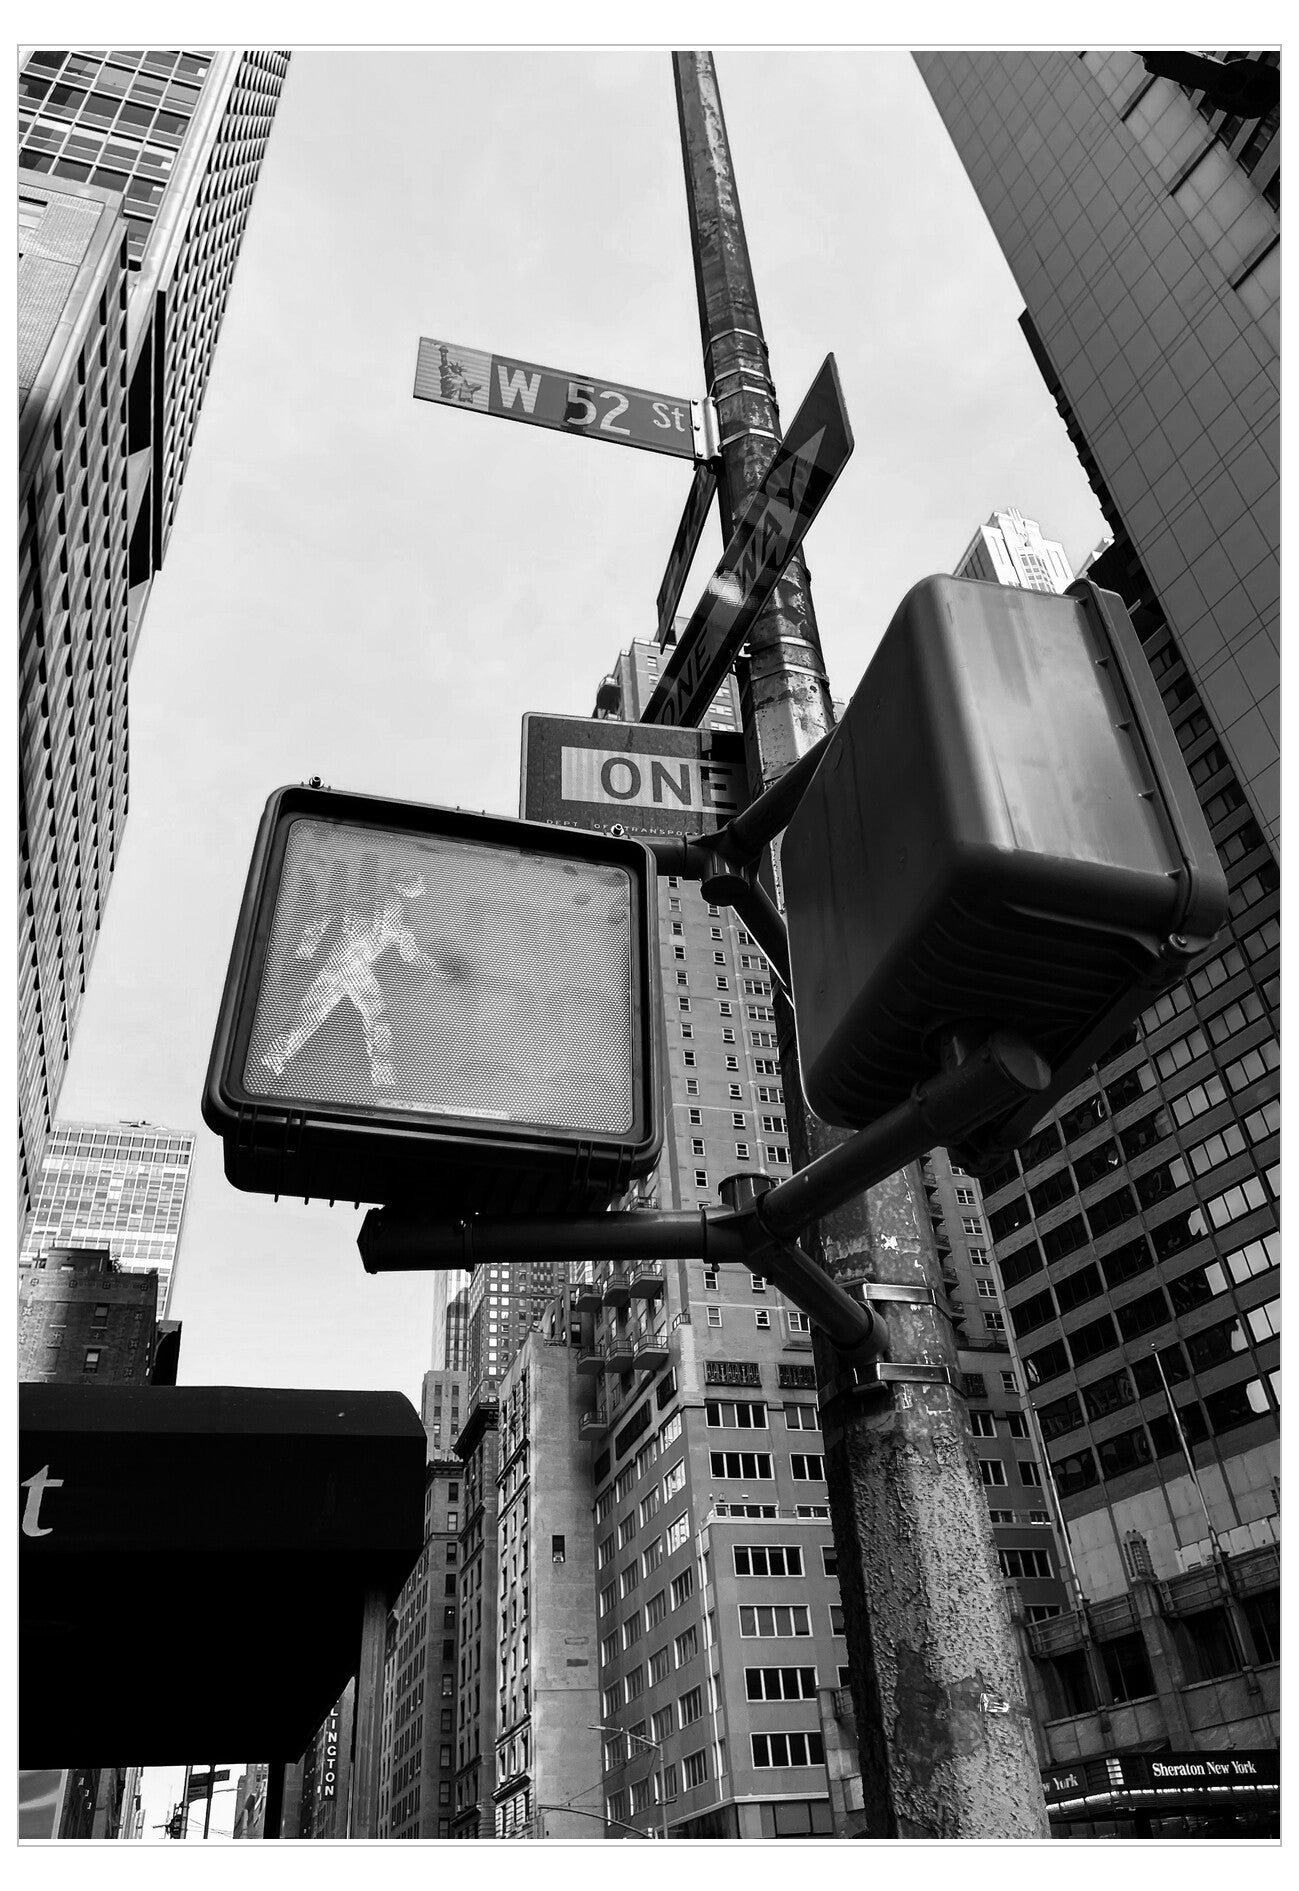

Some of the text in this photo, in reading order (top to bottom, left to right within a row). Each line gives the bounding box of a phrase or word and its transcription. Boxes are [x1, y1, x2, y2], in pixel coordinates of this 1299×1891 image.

[497, 365, 685, 436] W 52 St
[660, 625, 711, 726] ONE
[736, 455, 799, 598] WAY
[600, 756, 738, 811] ONE
[546, 819, 578, 827] DEPT
[324, 1707, 338, 1796] LINGTON
[1152, 1760, 1257, 1777] Sheraton New York
[1052, 1773, 1079, 1791] York
